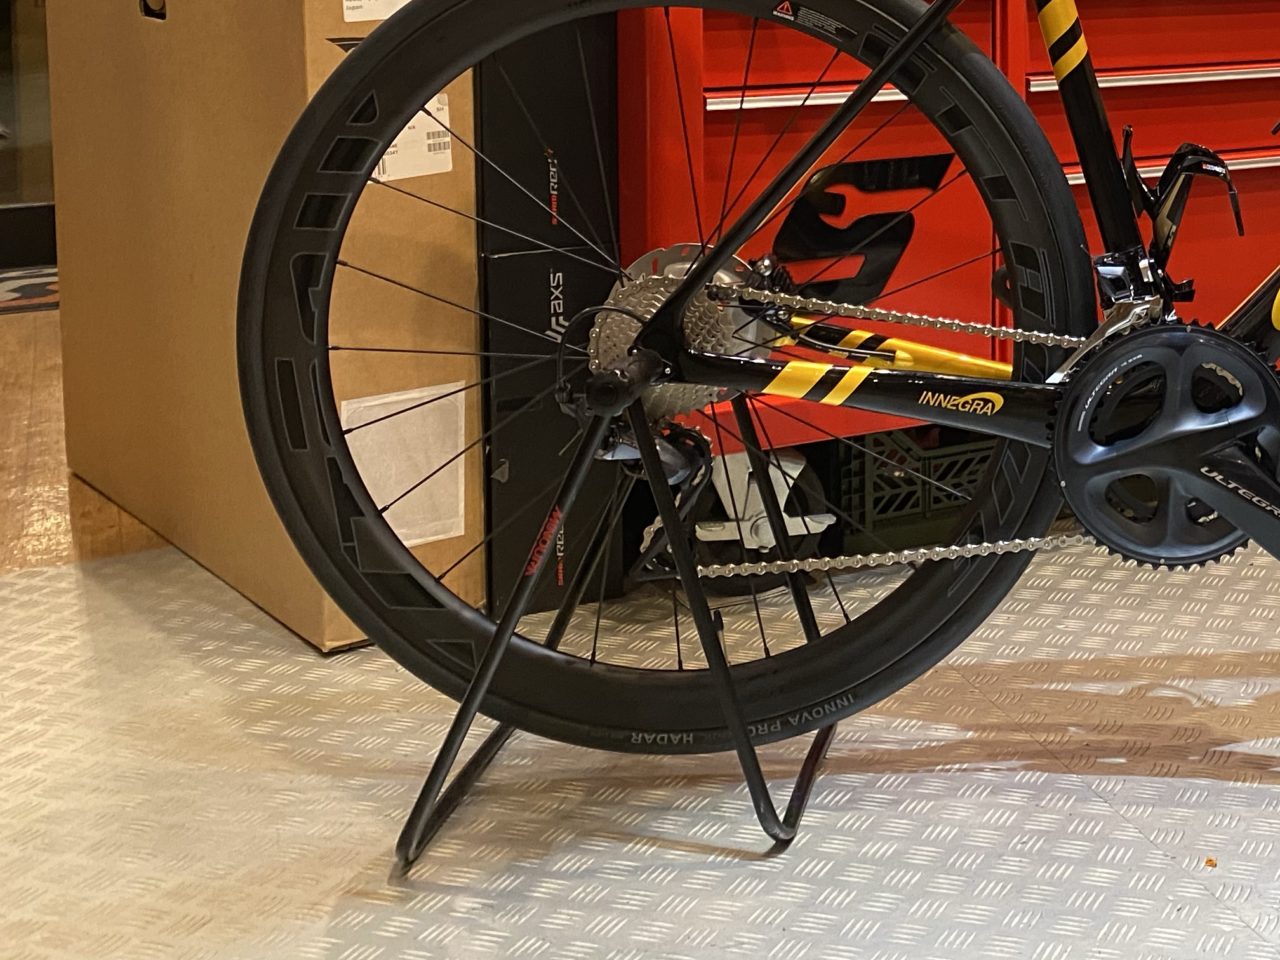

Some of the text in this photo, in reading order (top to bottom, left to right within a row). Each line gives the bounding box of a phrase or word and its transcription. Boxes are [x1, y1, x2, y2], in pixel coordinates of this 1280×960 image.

[550, 272, 564, 314] axs
[918, 390, 993, 416] INNEGRA
[788, 692, 855, 727] INNOVA
[631, 732, 694, 745] HADAR
